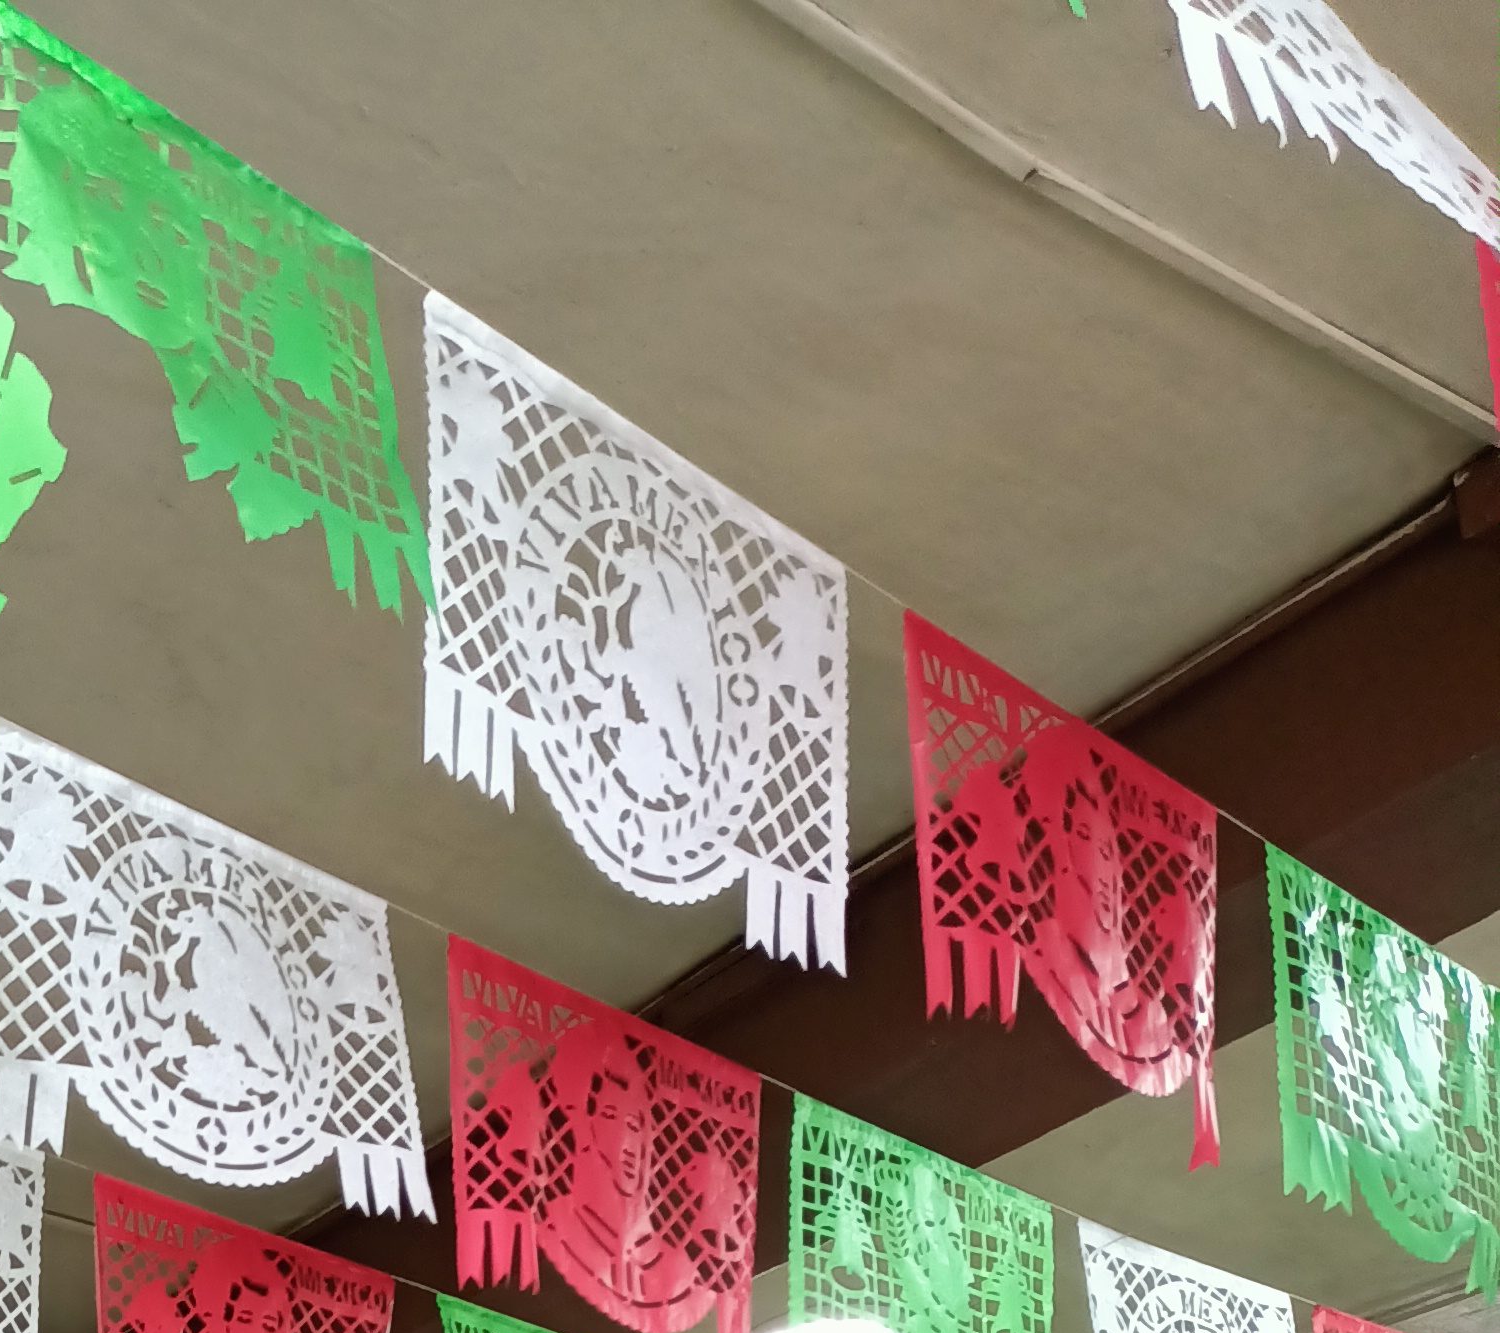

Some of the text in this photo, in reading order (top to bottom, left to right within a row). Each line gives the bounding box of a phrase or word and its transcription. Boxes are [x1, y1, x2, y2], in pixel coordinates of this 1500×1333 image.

[515, 465, 622, 575] VIVA
[83, 849, 172, 937] VIVA
[802, 1122, 871, 1172] VIVA
